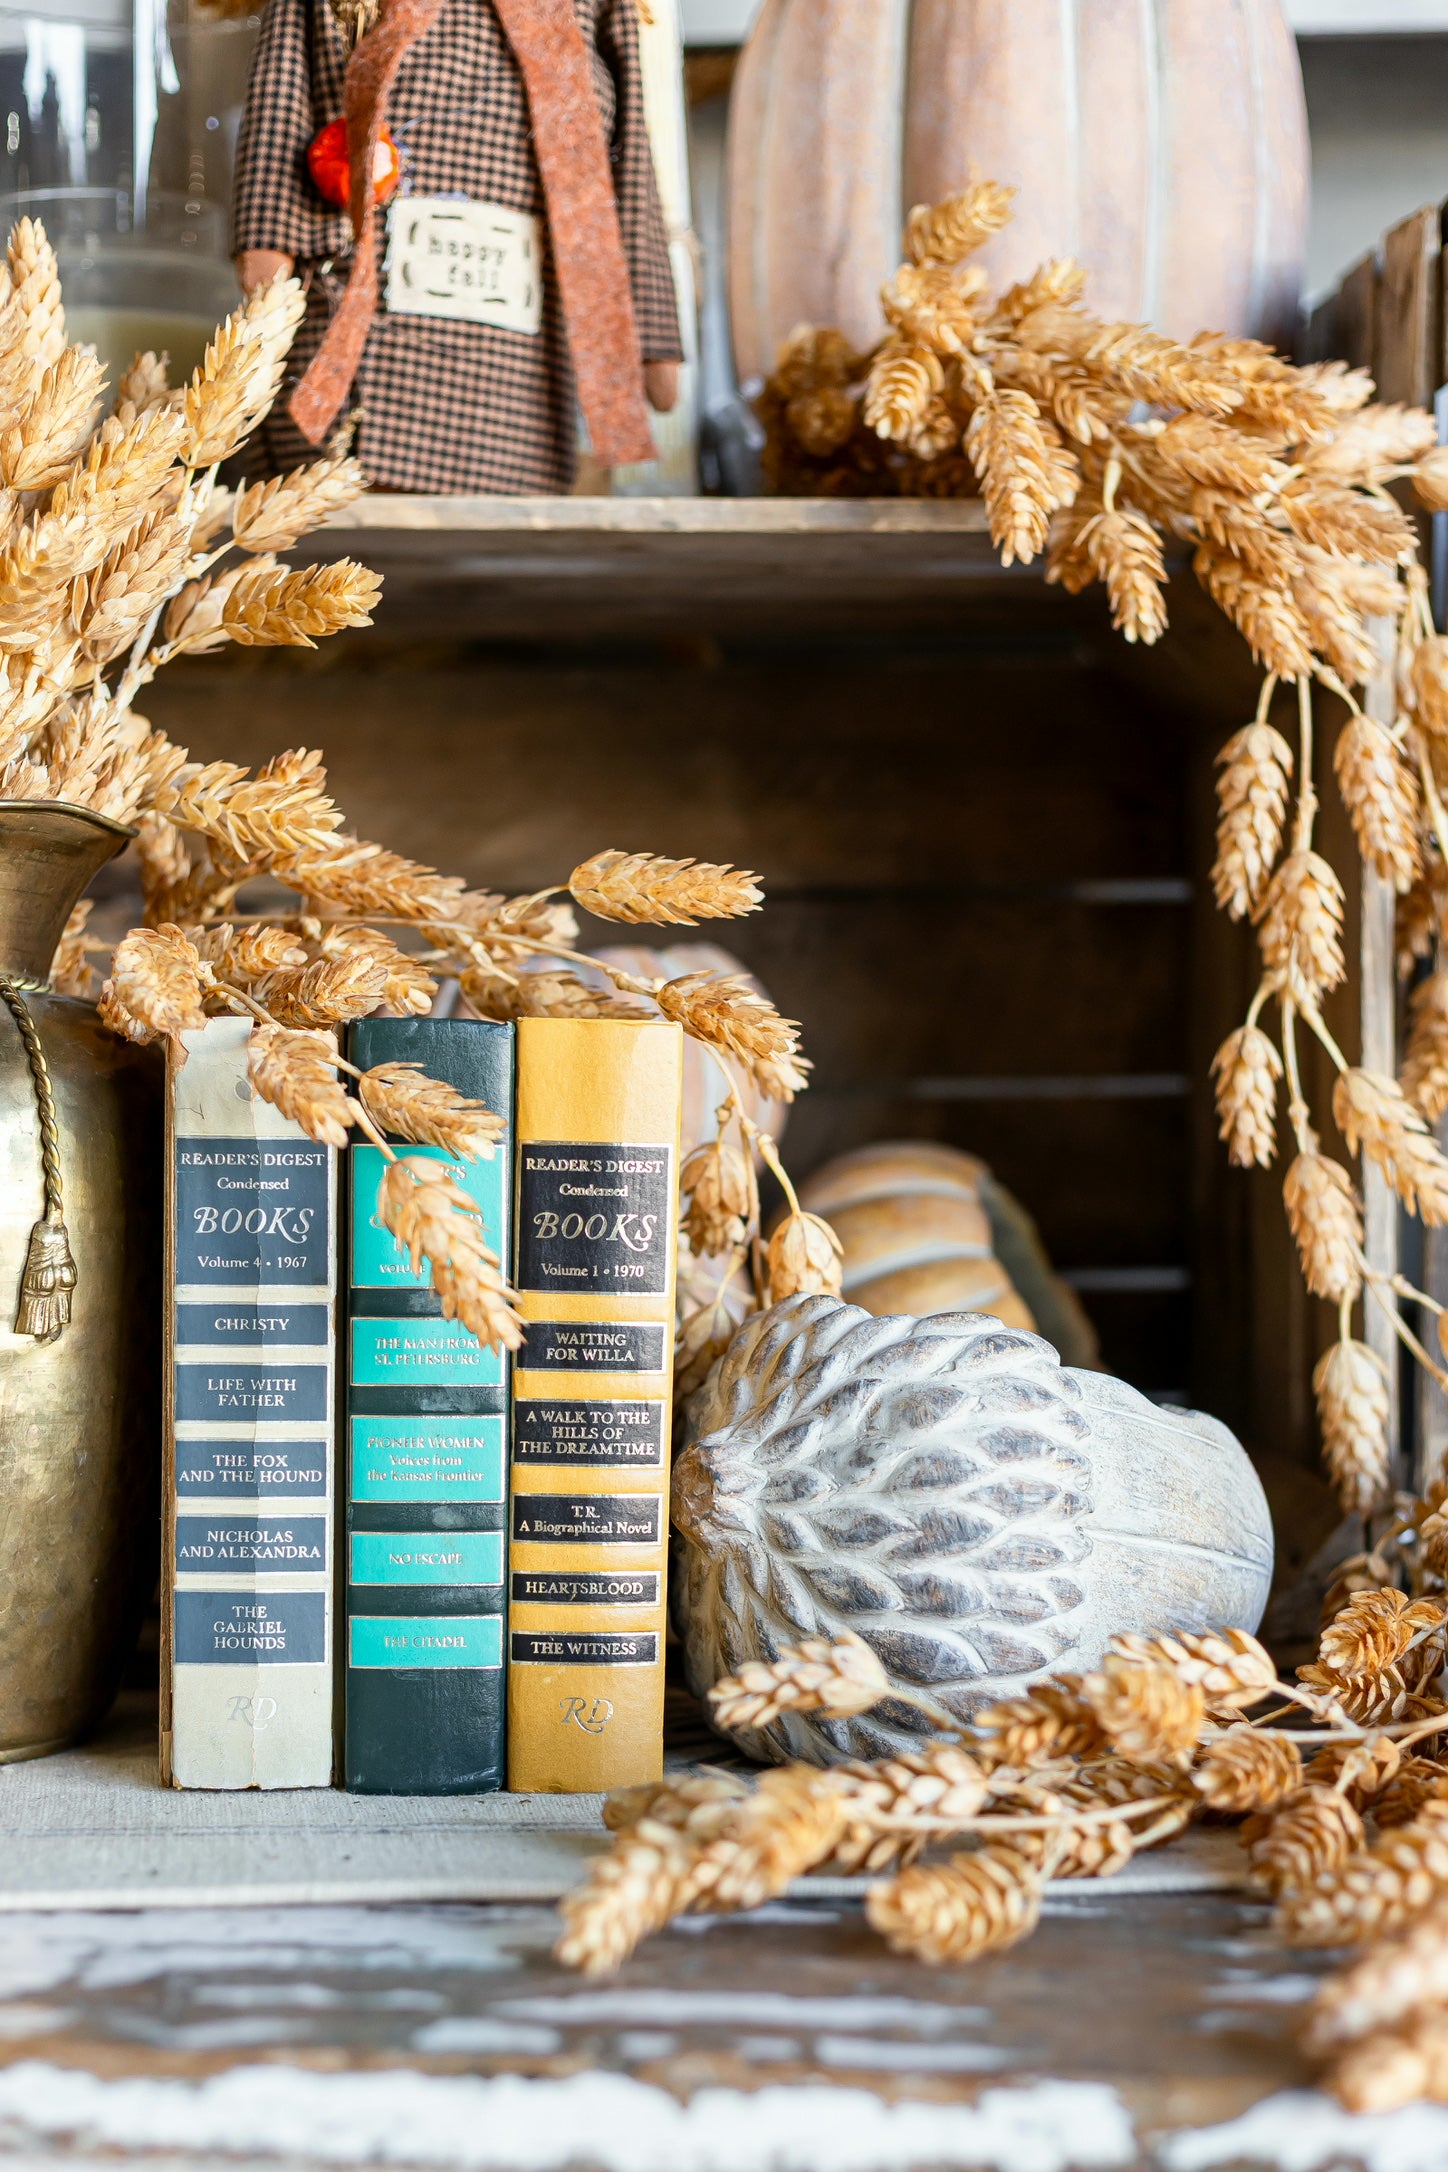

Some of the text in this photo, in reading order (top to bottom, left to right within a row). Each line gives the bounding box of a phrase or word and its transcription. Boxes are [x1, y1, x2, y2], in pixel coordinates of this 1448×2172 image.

[181, 1153, 325, 1166] READER'S DIGEST
[526, 1157, 664, 1174] READER'S DIGEST
[217, 1177, 289, 1190] Condensed
[559, 1183, 629, 1197] Condensed
[193, 1206, 314, 1244] BOOKS
[534, 1212, 658, 1252] BOOKS
[197, 1256, 307, 1268] Volume 4 1967
[380, 1264, 425, 1273] VOLUE
[541, 1263, 645, 1278] Volume 1 1970
[215, 1318, 289, 1331] CHRISTY
[375, 1337, 480, 1349] THE MAN FROM
[555, 1332, 627, 1346] WAITING
[396, 1354, 481, 1366] PETERSBURG
[546, 1348, 634, 1362] FOR WILLA
[208, 1379, 296, 1391] LIFE WITH
[218, 1394, 285, 1407] FATHER
[526, 1411, 650, 1425] A WALK TO THE
[552, 1427, 625, 1440] HILLS OF
[367, 1436, 485, 1449] PIONEER WOMEN
[520, 1441, 655, 1456] THE DREAMTIME
[213, 1454, 288, 1467] THE FOX
[390, 1454, 462, 1466] Voices from
[179, 1470, 322, 1483] AND THE HOUND
[368, 1470, 484, 1482] the Kansas Frontier
[519, 1520, 652, 1536] A Biographical Novel
[207, 1530, 293, 1543] NICHOLAS
[180, 1546, 321, 1559] AND ALEXANDRA
[390, 1553, 462, 1565] NO ESCAPE
[525, 1581, 644, 1595] HEARTSBLOOD
[232, 1605, 268, 1618] THE
[214, 1621, 287, 1634] GABRIEL
[214, 1637, 286, 1649] HOUNDS
[384, 1636, 467, 1648] THE CITADEL
[530, 1641, 637, 1655] THE WITNESS
